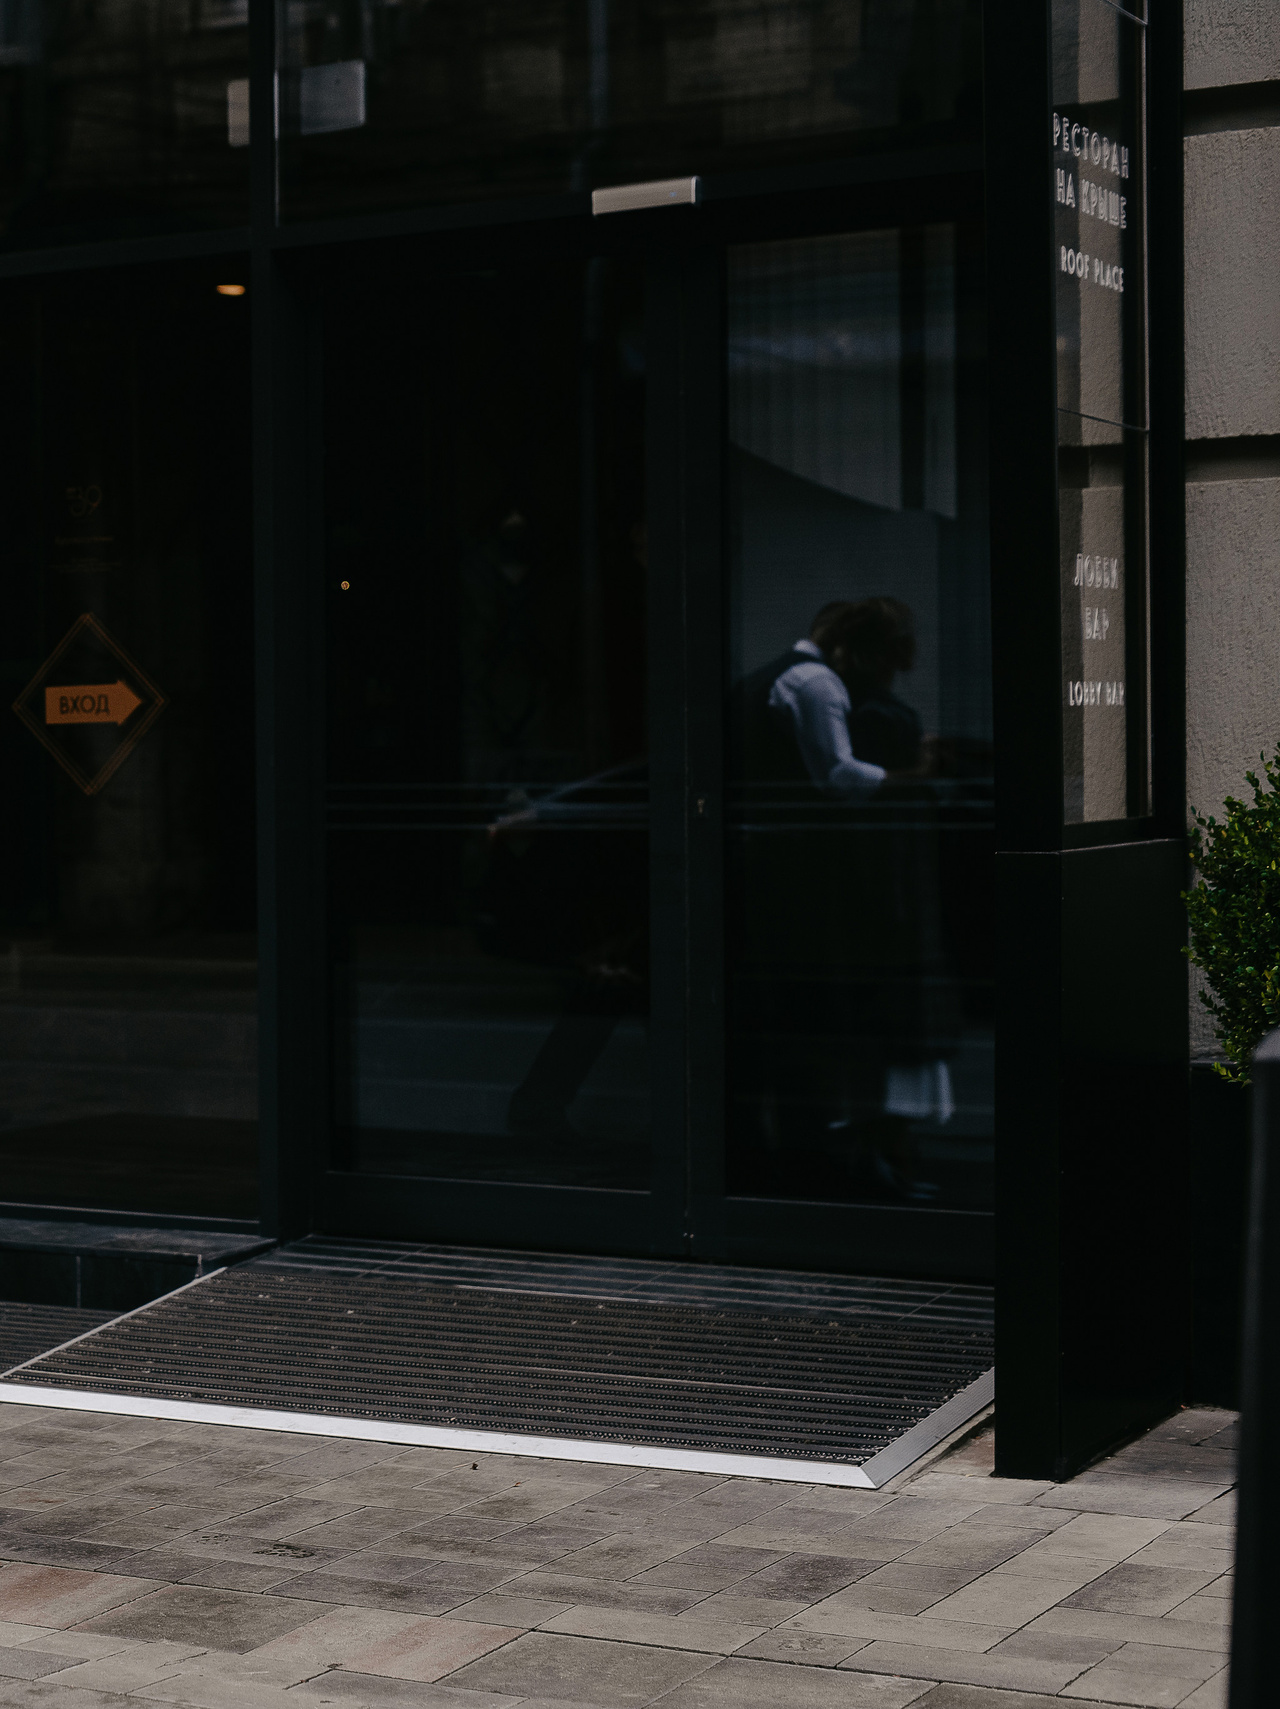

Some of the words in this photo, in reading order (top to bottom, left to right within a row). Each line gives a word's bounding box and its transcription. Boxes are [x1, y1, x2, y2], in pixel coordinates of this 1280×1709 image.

[1053, 112, 1129, 179] РЕСТОРАН
[1056, 168, 1076, 208] НА
[1081, 179, 1127, 229] КРЫШЕ
[1061, 245, 1090, 279] ROOF
[1094, 258, 1125, 292] PLACE
[58, 693, 111, 716] ВХОД
[1069, 681, 1102, 706] LOBBY
